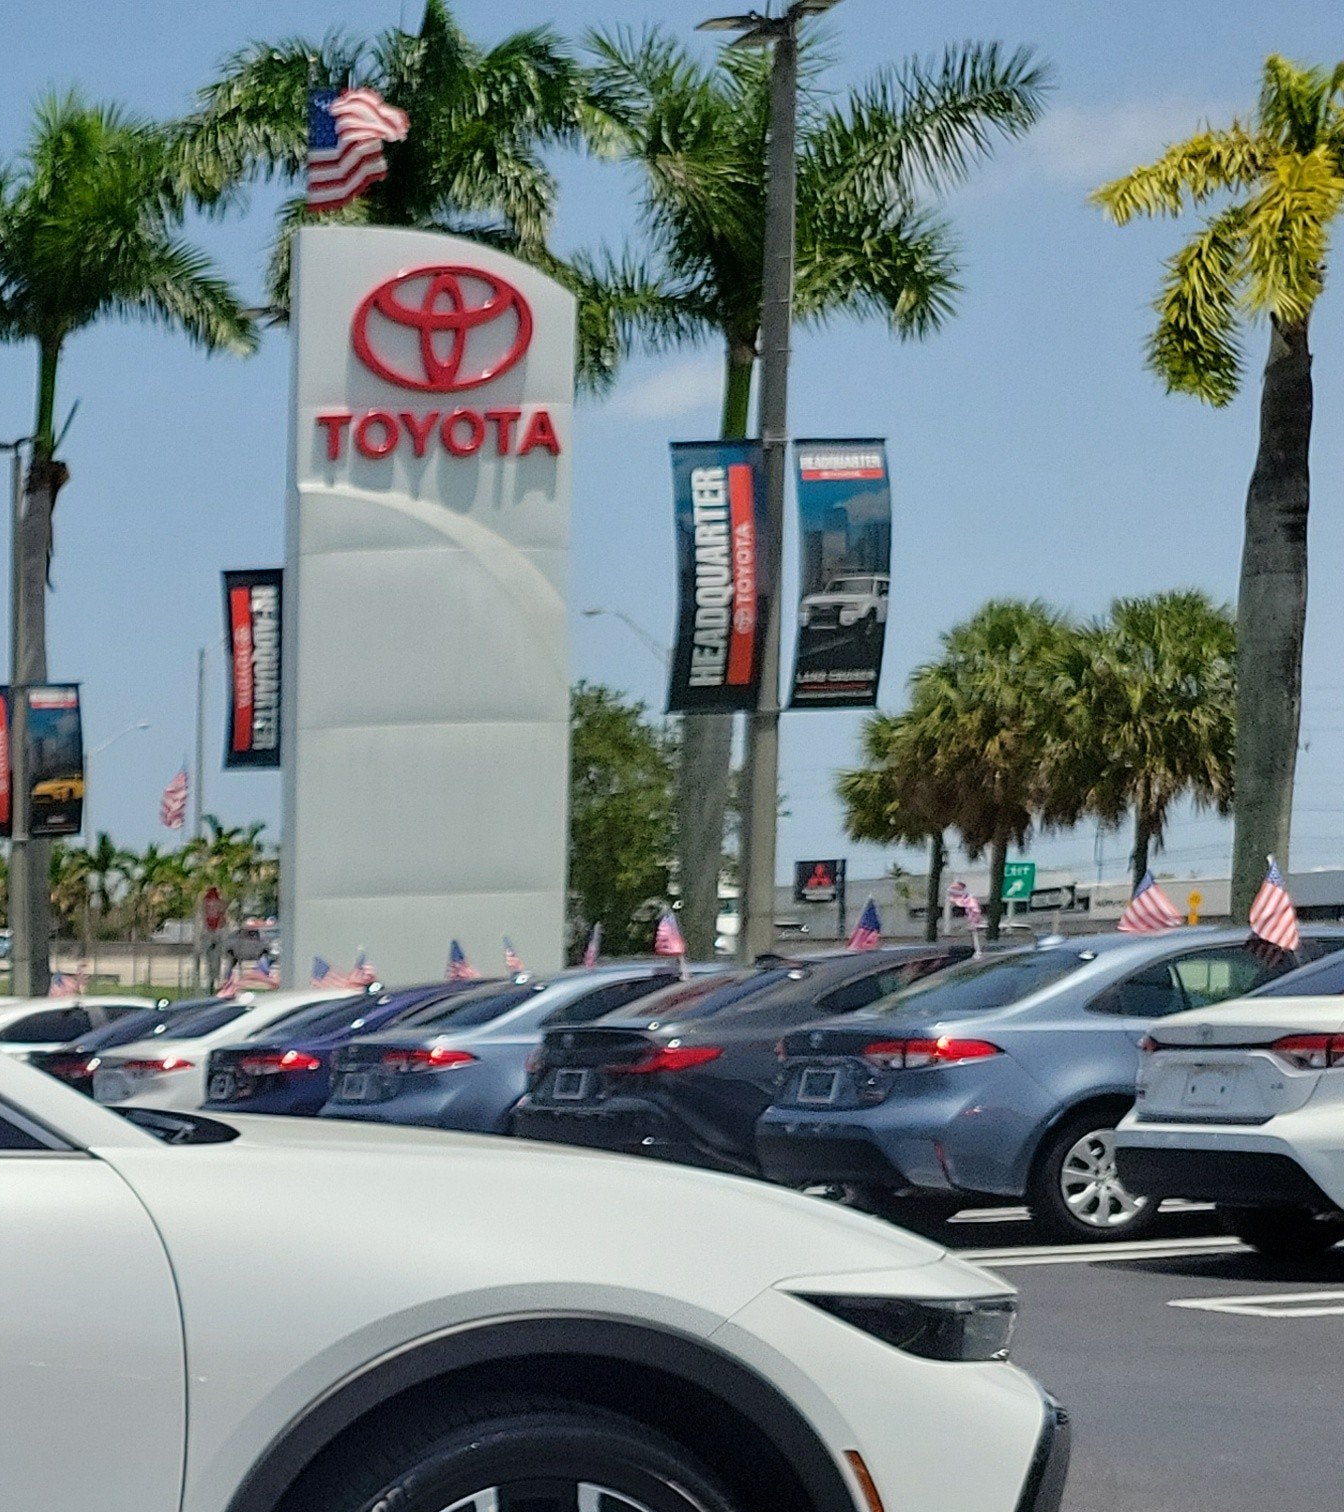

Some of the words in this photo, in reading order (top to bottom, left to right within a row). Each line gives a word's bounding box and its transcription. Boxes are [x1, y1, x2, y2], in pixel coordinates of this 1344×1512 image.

[315, 408, 561, 461] TOYOTA
[688, 467, 734, 687] HEADQUARTER
[736, 521, 755, 603] TOYOTA
